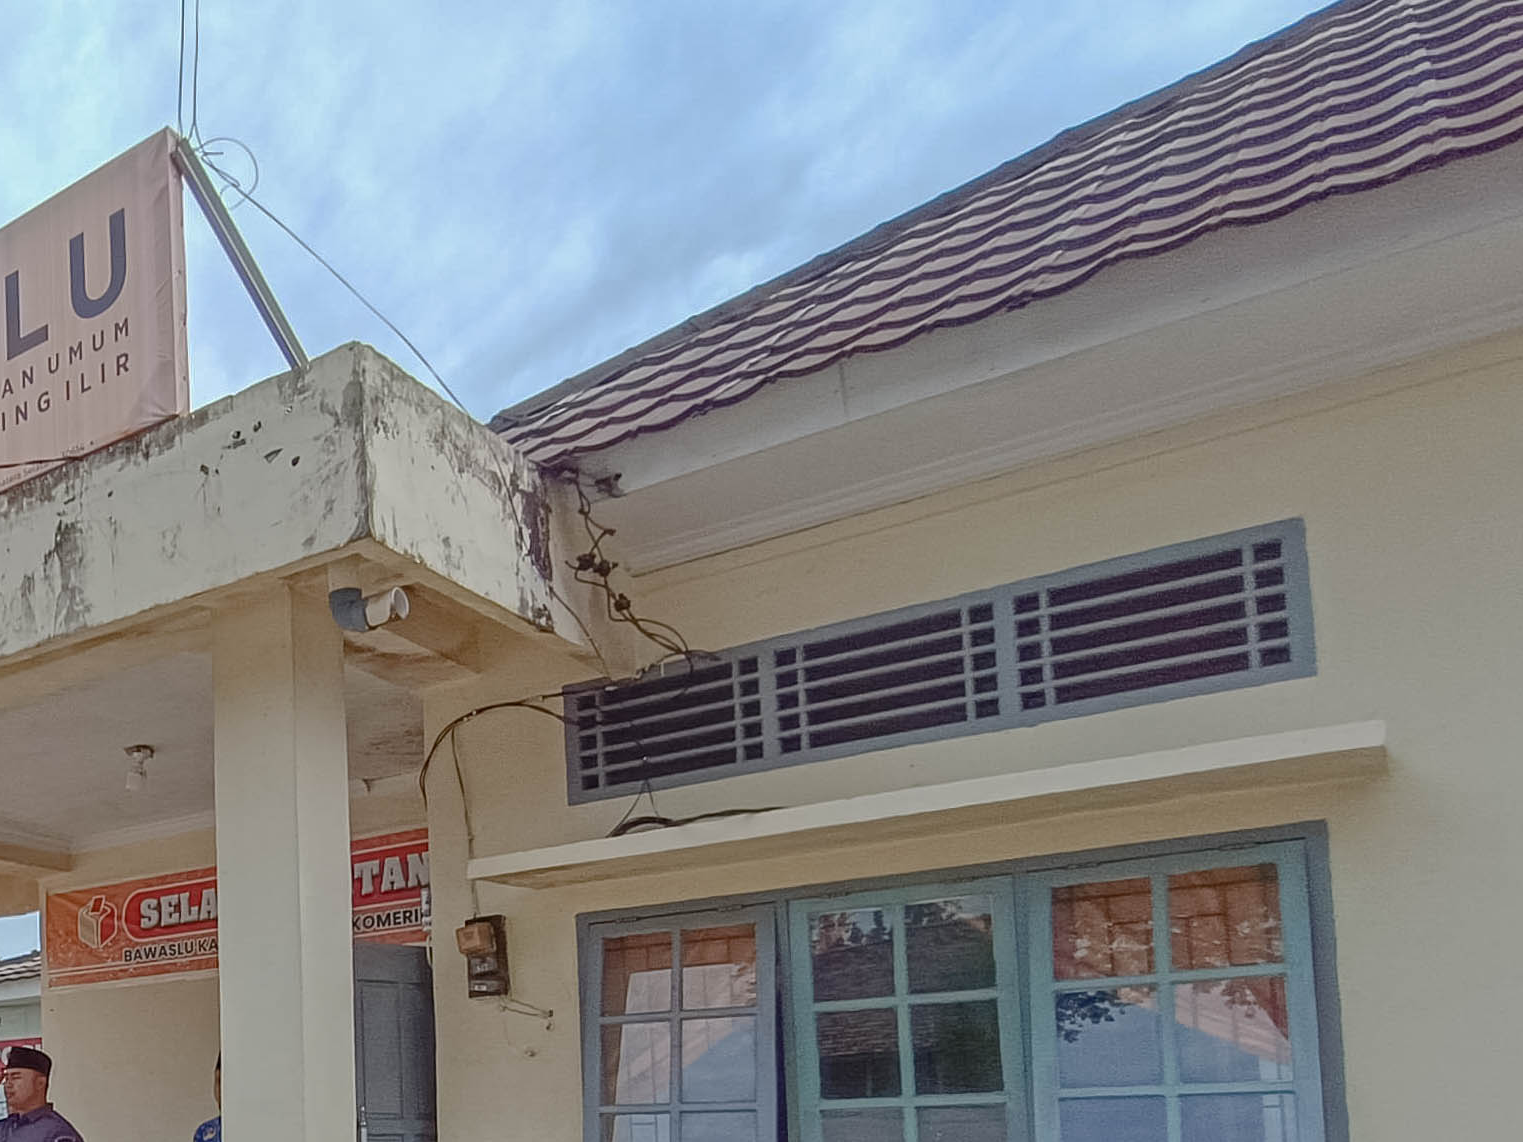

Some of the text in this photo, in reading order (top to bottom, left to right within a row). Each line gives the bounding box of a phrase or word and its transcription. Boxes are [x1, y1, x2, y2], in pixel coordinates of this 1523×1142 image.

[48, 317, 129, 374] UMUM
[65, 352, 130, 401] ILIR
[140, 852, 429, 929] SELA TAN
[124, 941, 194, 962] BAWASLU
[352, 909, 423, 931] KOMERI
